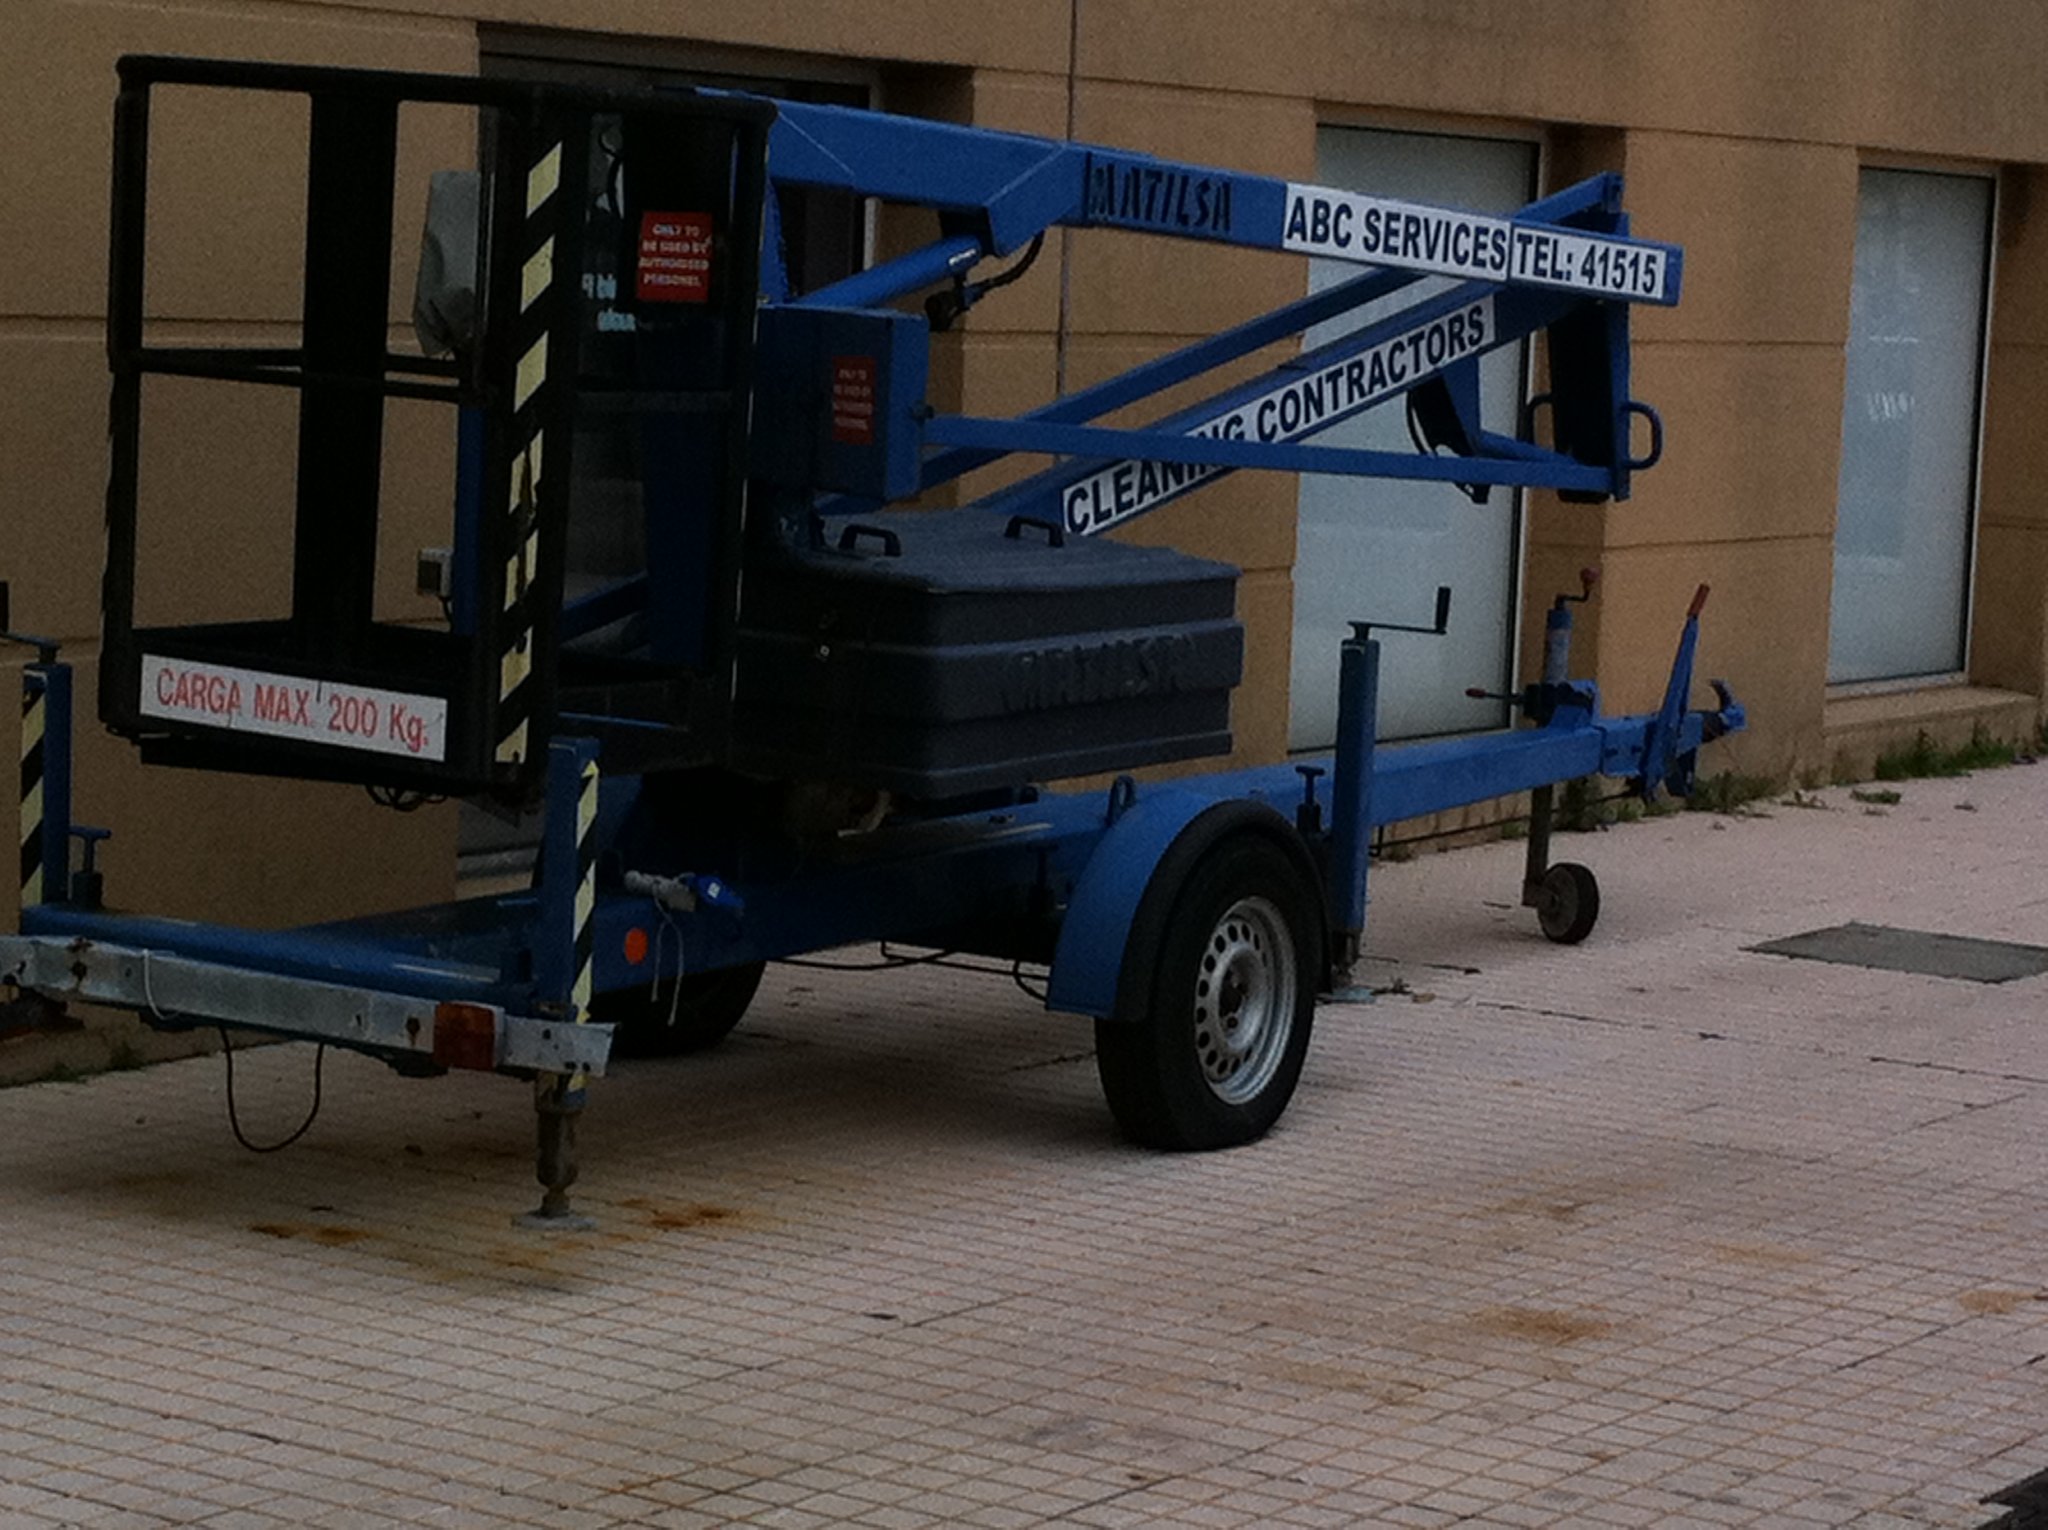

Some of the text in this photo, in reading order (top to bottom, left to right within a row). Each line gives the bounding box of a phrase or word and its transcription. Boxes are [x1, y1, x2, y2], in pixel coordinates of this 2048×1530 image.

[1286, 195, 1508, 272] ABC SERVICES
[1515, 231, 1657, 295] TEL: 41515
[1257, 304, 1485, 443] CONTRACTORS
[156, 667, 241, 715] CARGA
[328, 693, 378, 738] 200
[389, 703, 429, 753] Kg.
